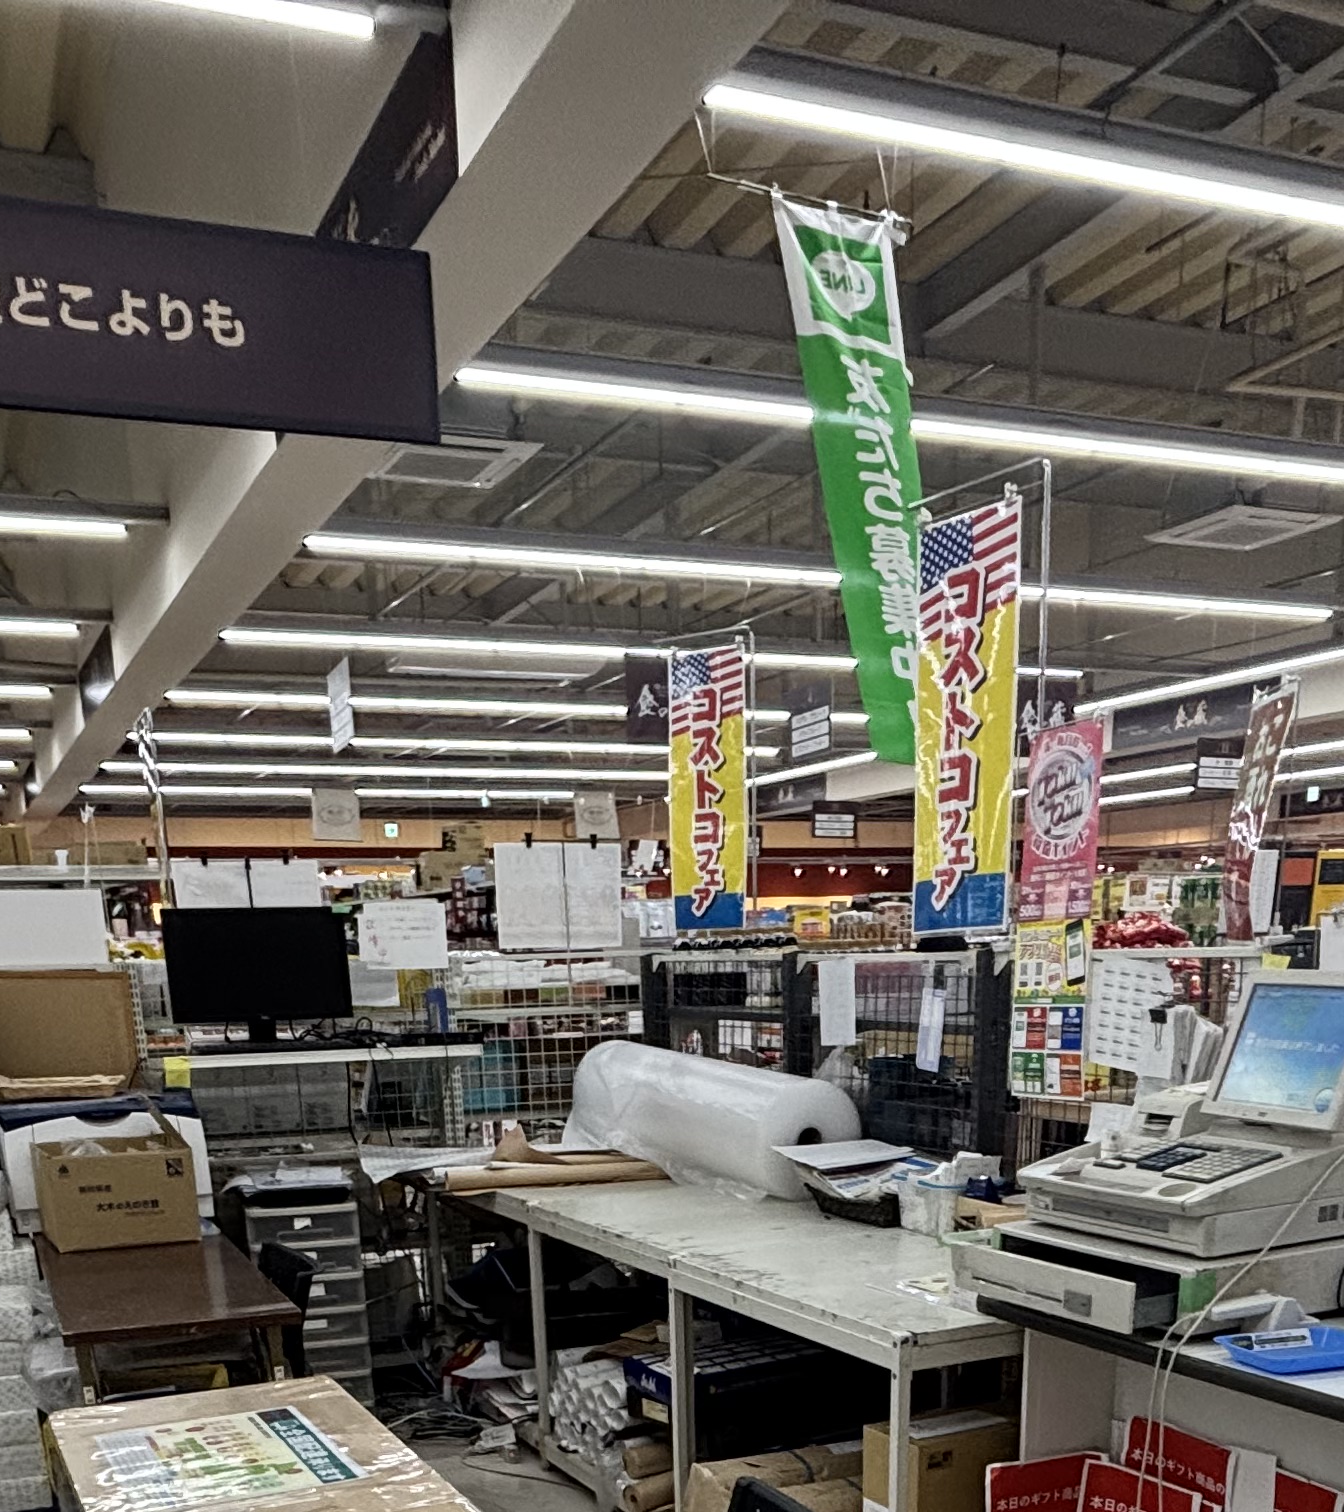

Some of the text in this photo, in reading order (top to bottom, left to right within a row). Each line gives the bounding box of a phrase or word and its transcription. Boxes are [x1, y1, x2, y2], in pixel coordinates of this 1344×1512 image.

[687, 685, 726, 914] コストコフェア
[931, 563, 986, 911] コストコフェア
[1130, 1448, 1226, 1496] 本日のギフト商品の
